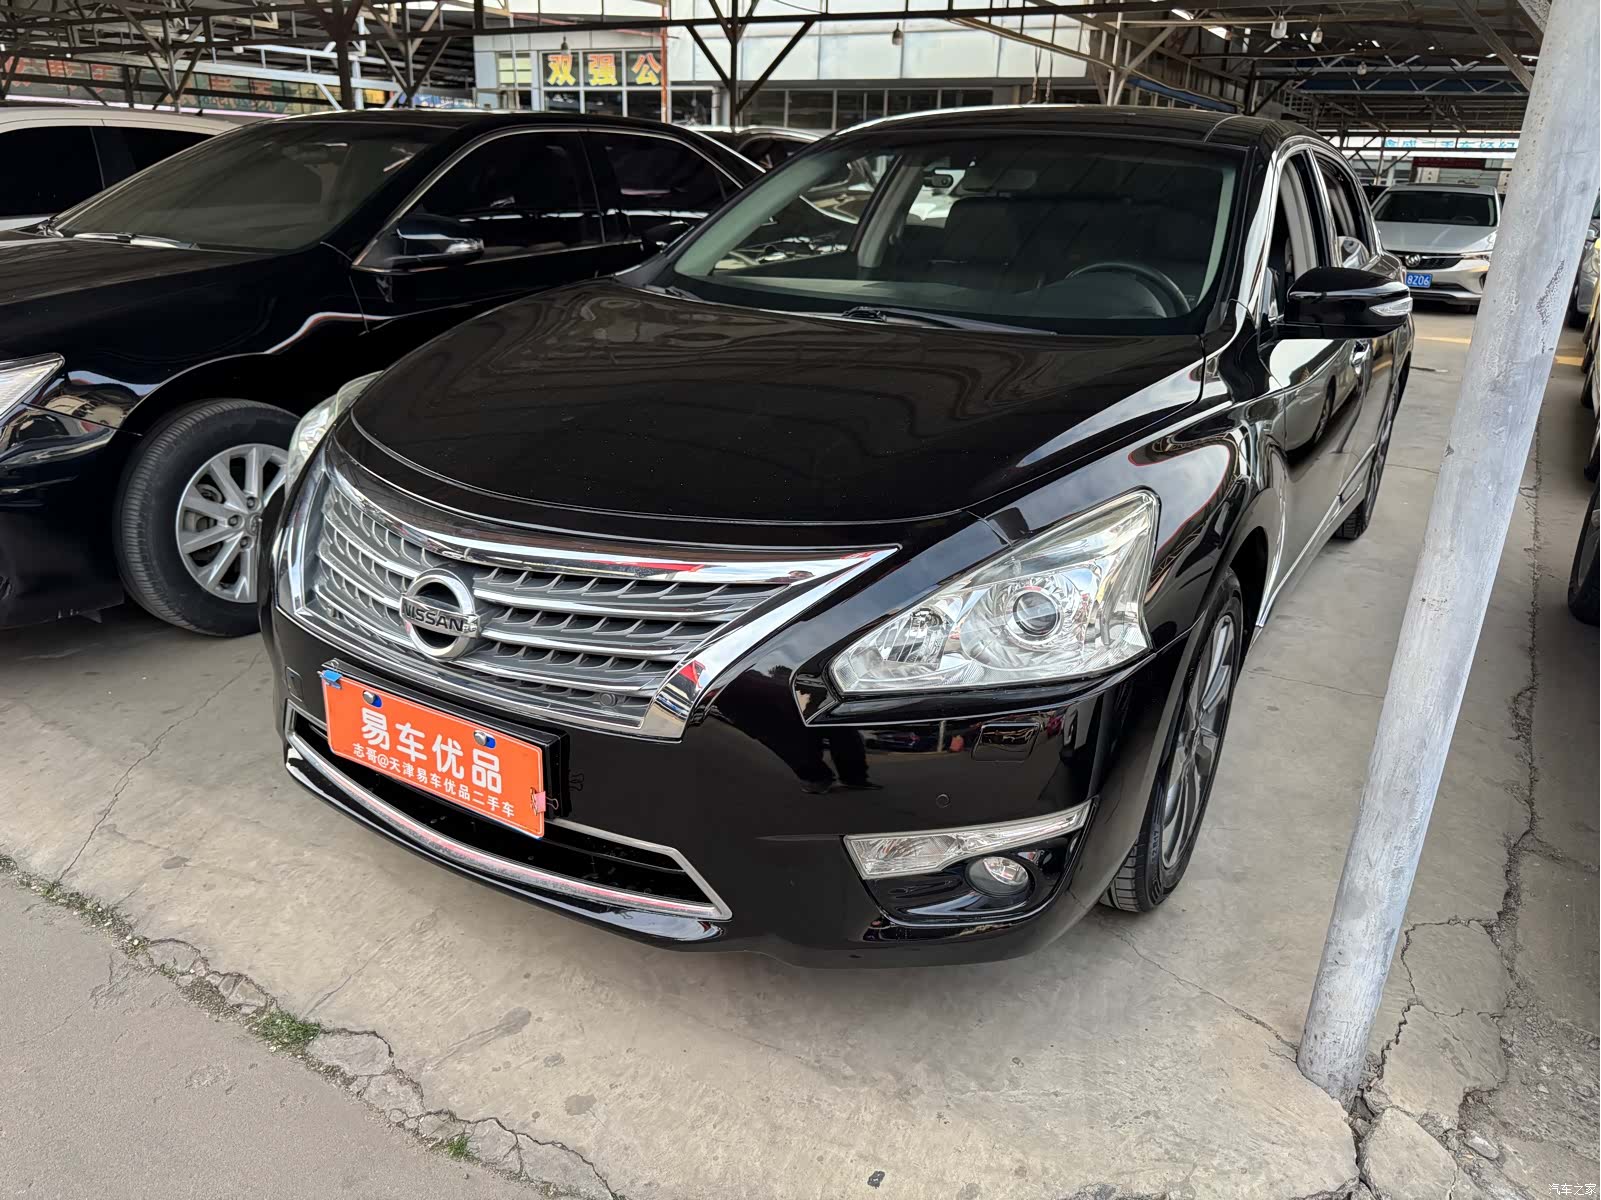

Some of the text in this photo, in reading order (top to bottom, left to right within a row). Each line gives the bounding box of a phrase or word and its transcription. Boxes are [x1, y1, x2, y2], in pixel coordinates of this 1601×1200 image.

[547, 53, 662, 86] 双强公
[402, 602, 464, 632] NISSAN
[361, 706, 503, 794] 易车优品
[352, 743, 516, 818] 志哥@天津易车优品二手车
